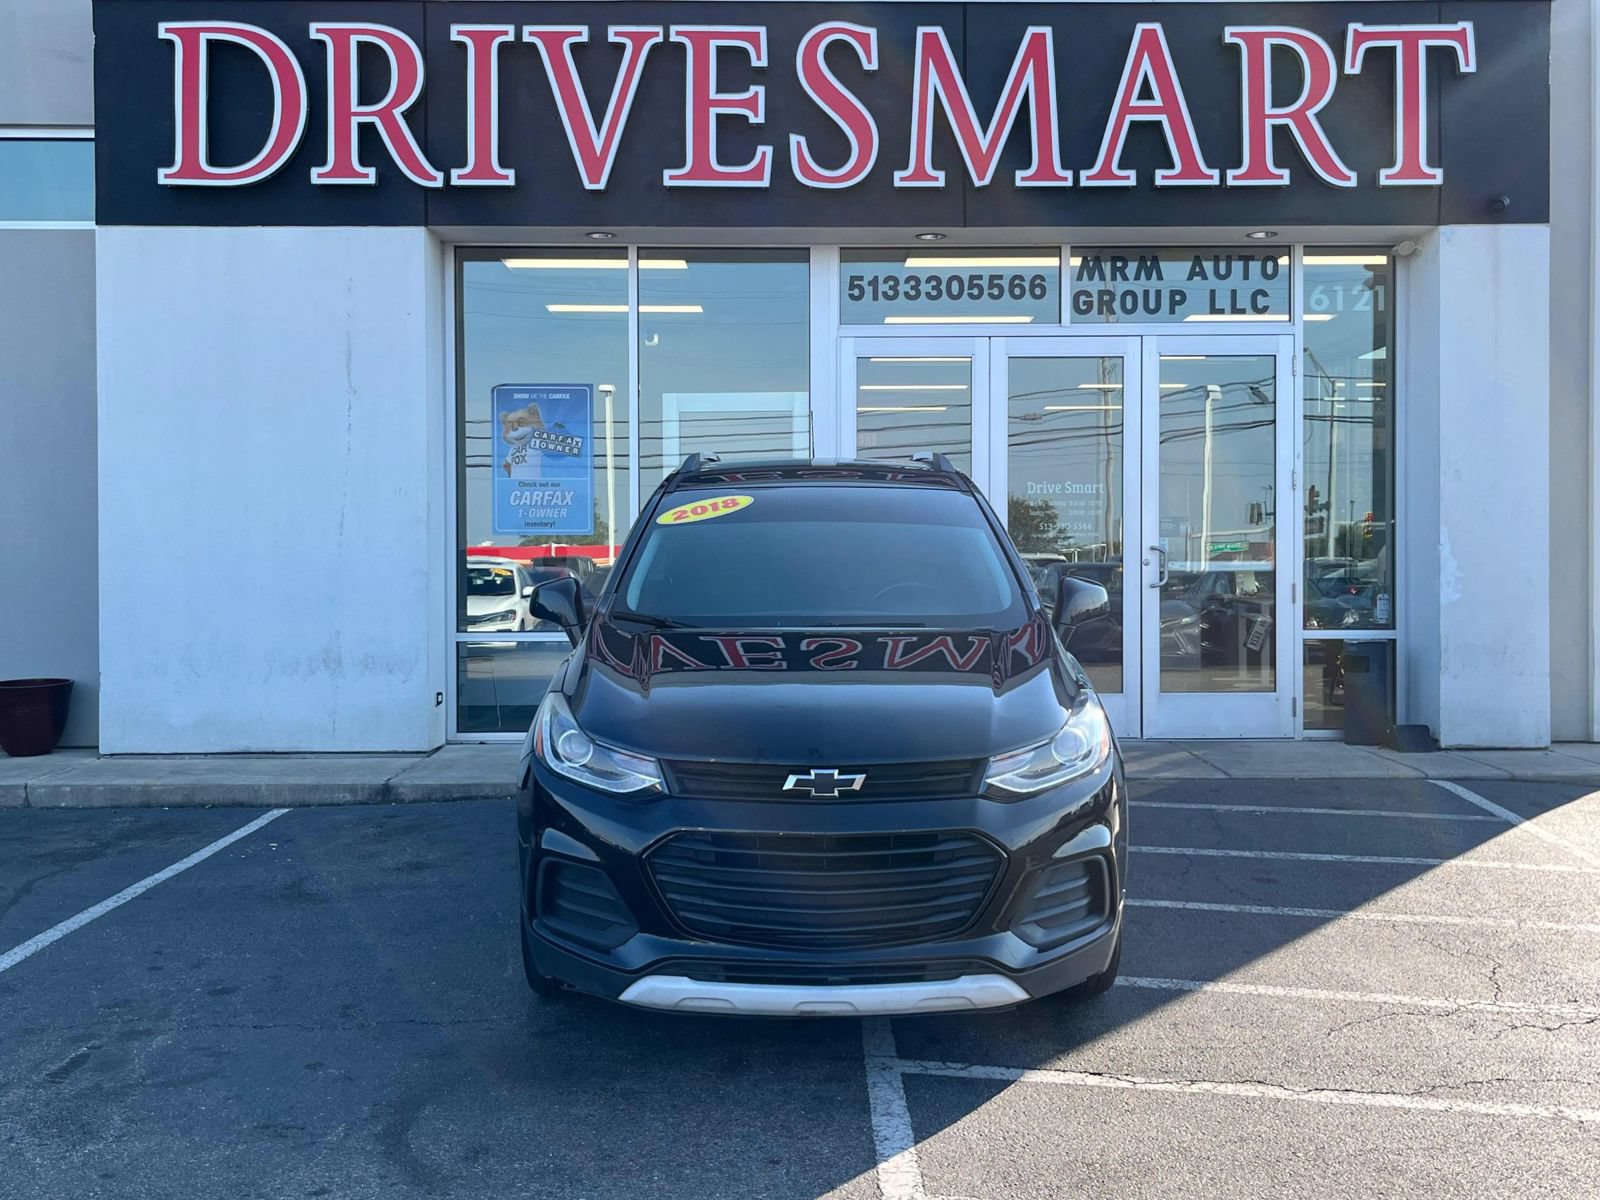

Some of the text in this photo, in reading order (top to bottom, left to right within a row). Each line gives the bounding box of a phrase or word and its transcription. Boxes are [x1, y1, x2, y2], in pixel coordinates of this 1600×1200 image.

[157, 20, 1476, 190] DRIVESMART
[1076, 255, 1280, 282] MRM AUTO
[847, 274, 1048, 302] 5133305566
[1309, 284, 1385, 312] 6121
[1072, 288, 1272, 316] GROUP LLC
[533, 431, 582, 448] CARFAX
[509, 490, 575, 506] CARFAX
[1027, 481, 1104, 494] Drive Smart
[518, 508, 567, 519] 1-OWNER
[672, 497, 739, 523] 2018
